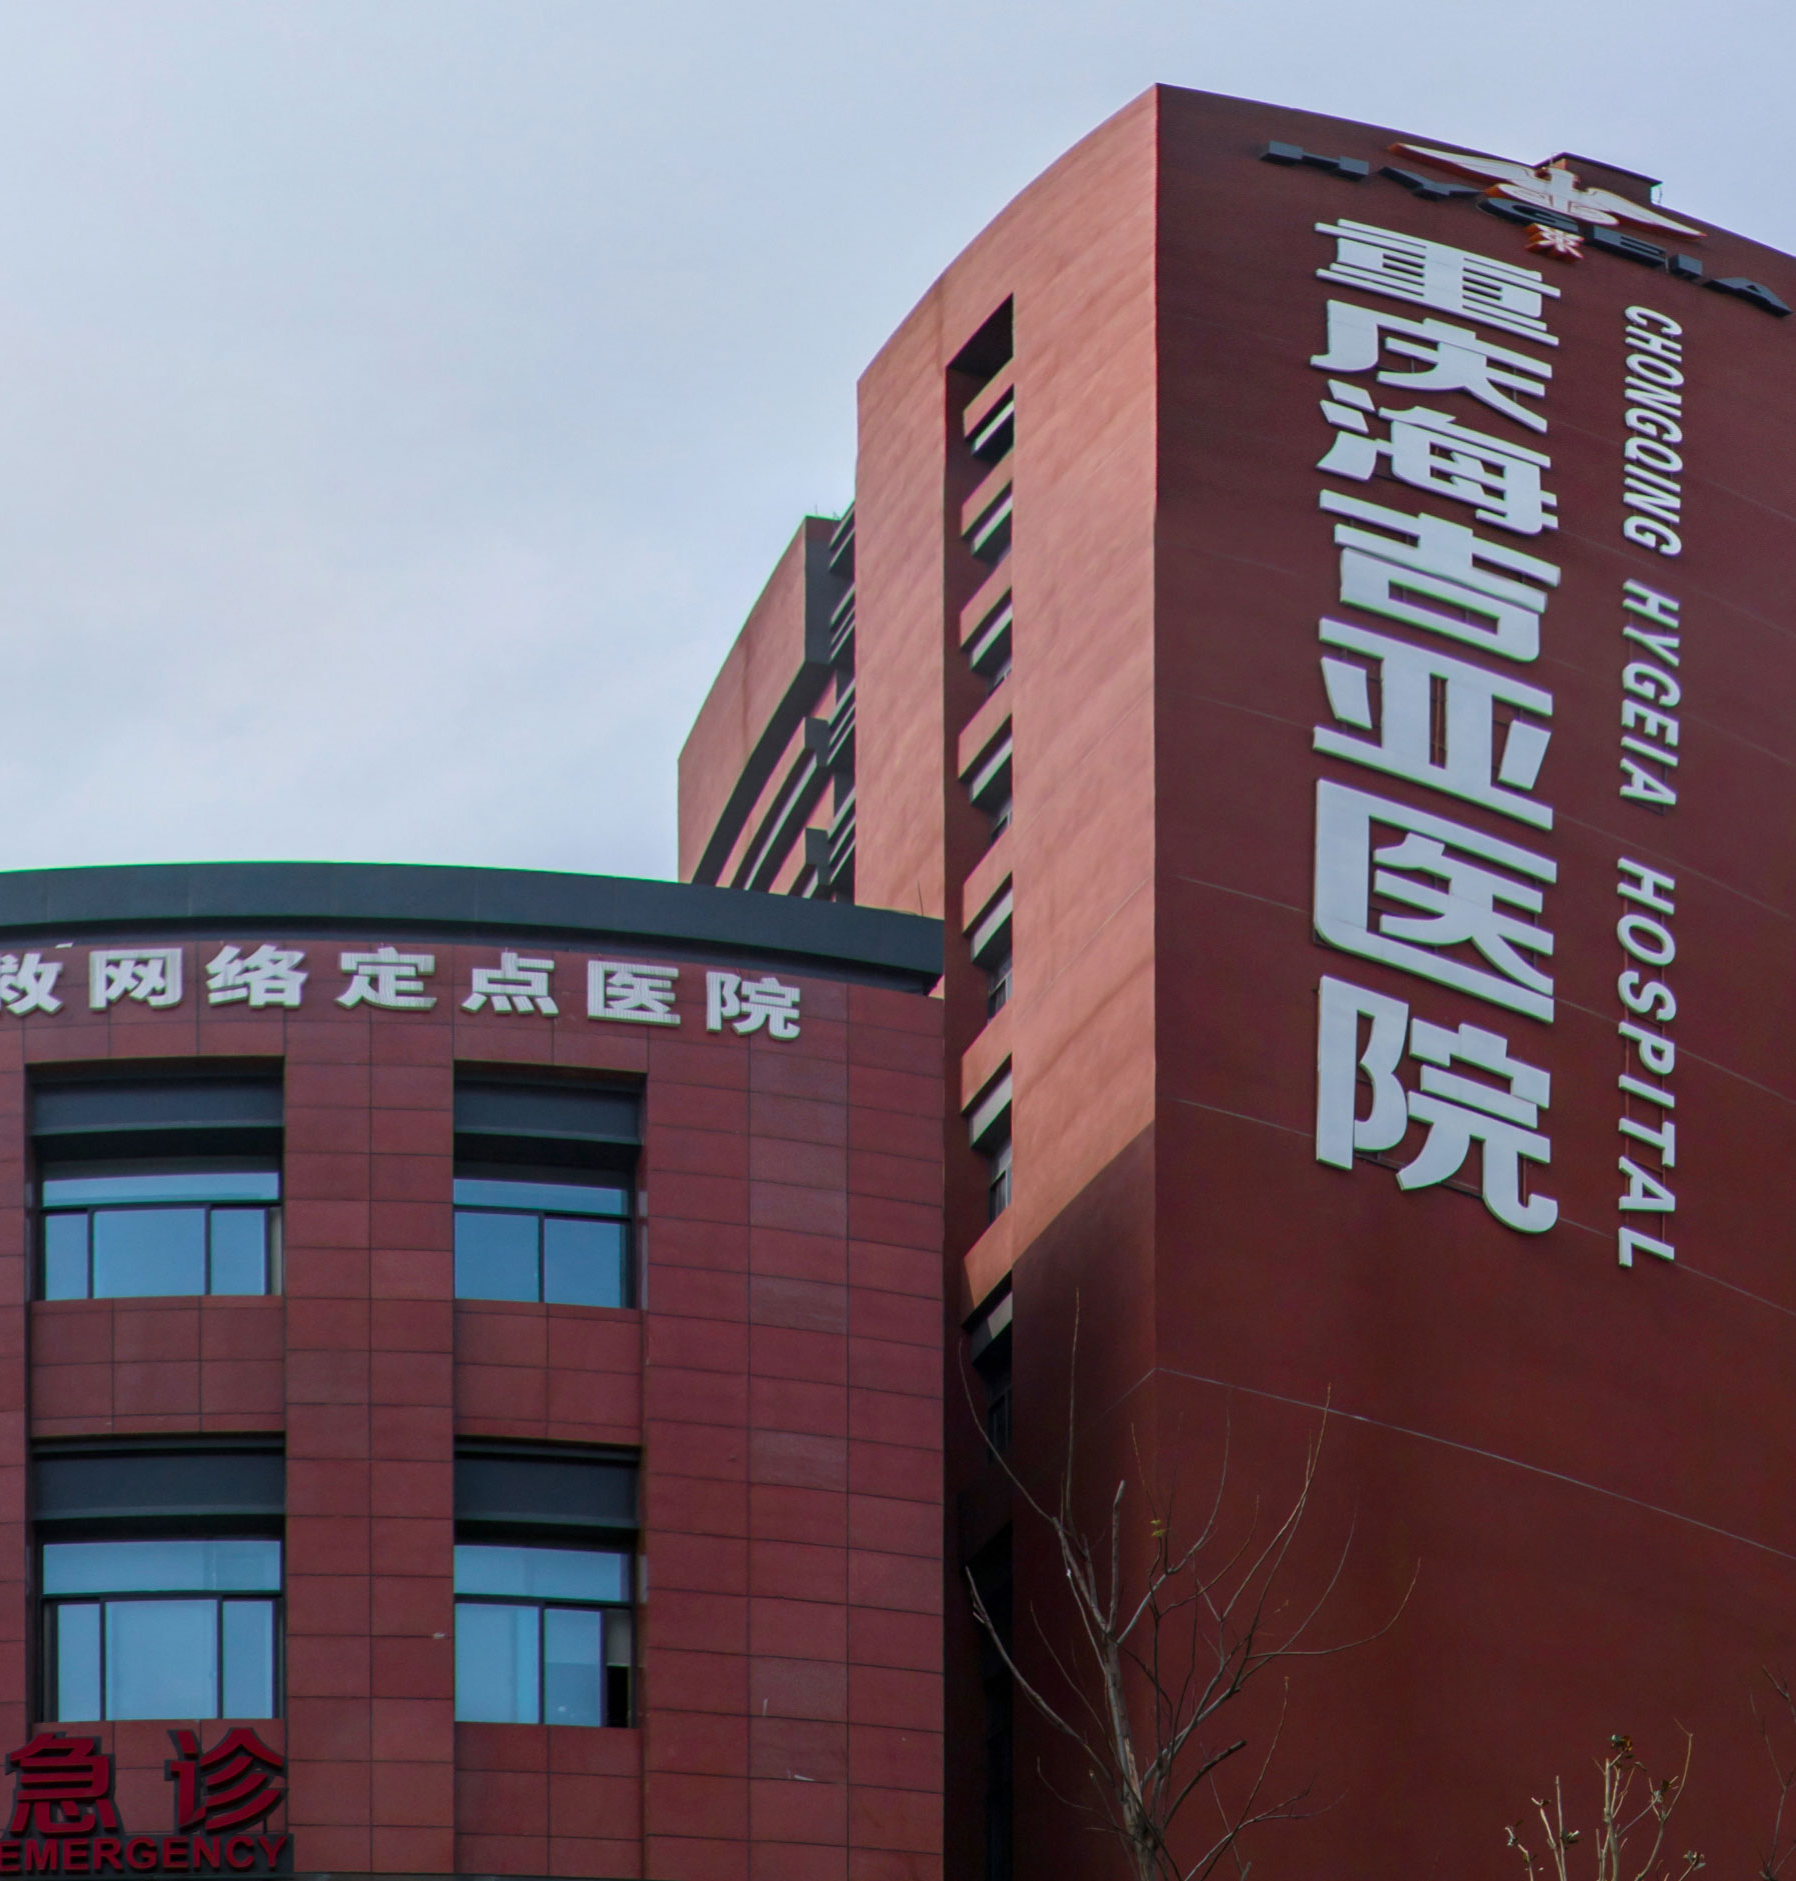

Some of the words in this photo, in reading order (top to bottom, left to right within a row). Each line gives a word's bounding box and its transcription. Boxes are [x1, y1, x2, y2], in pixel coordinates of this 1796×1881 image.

[1622, 305, 1684, 557] CHONGQING
[1309, 219, 1561, 1233] 重庆海吉亚医院
[1619, 578, 1681, 806] HYGEIA
[1616, 857, 1677, 1267] HOSPITAL
[7, 1727, 287, 1836] 急诊
